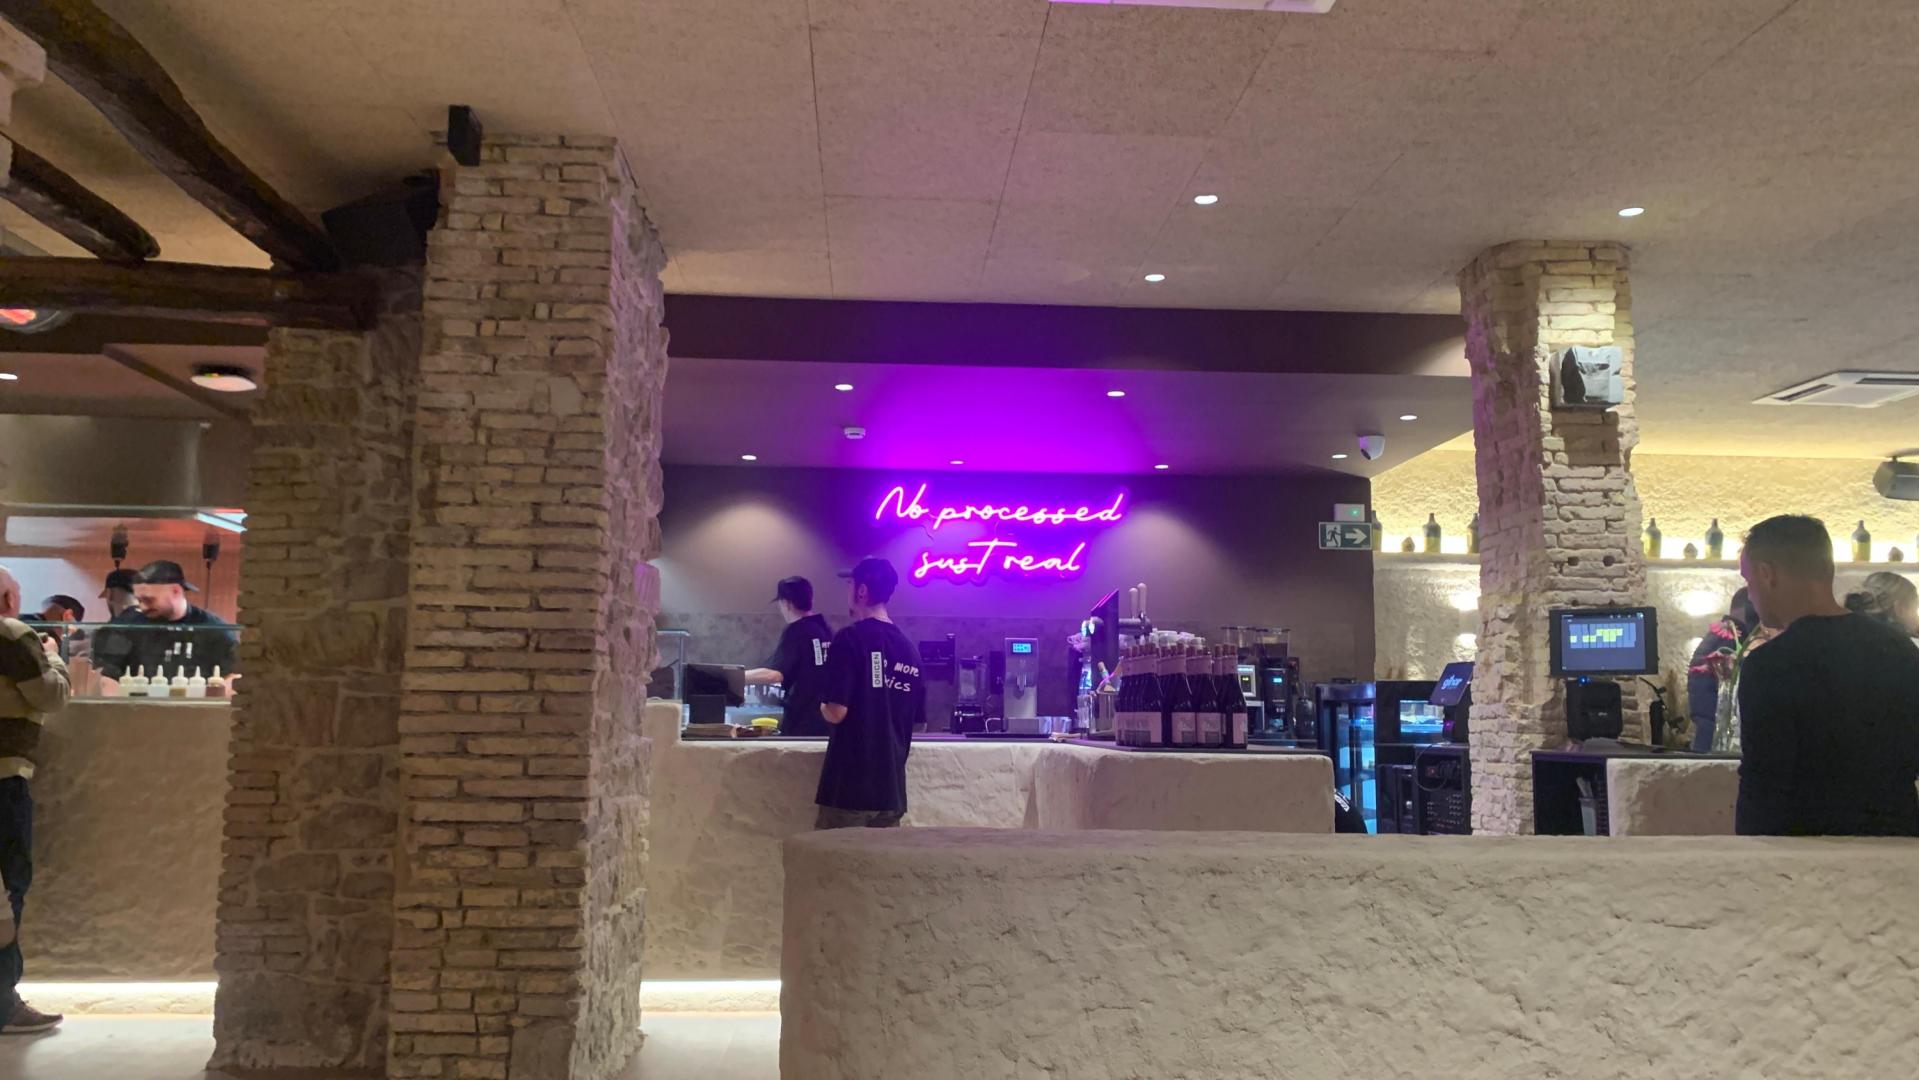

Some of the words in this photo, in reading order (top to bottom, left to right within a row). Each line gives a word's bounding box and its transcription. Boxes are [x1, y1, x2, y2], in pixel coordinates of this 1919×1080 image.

[876, 483, 929, 520] No
[933, 493, 1123, 530] processed
[1003, 541, 1085, 571] real
